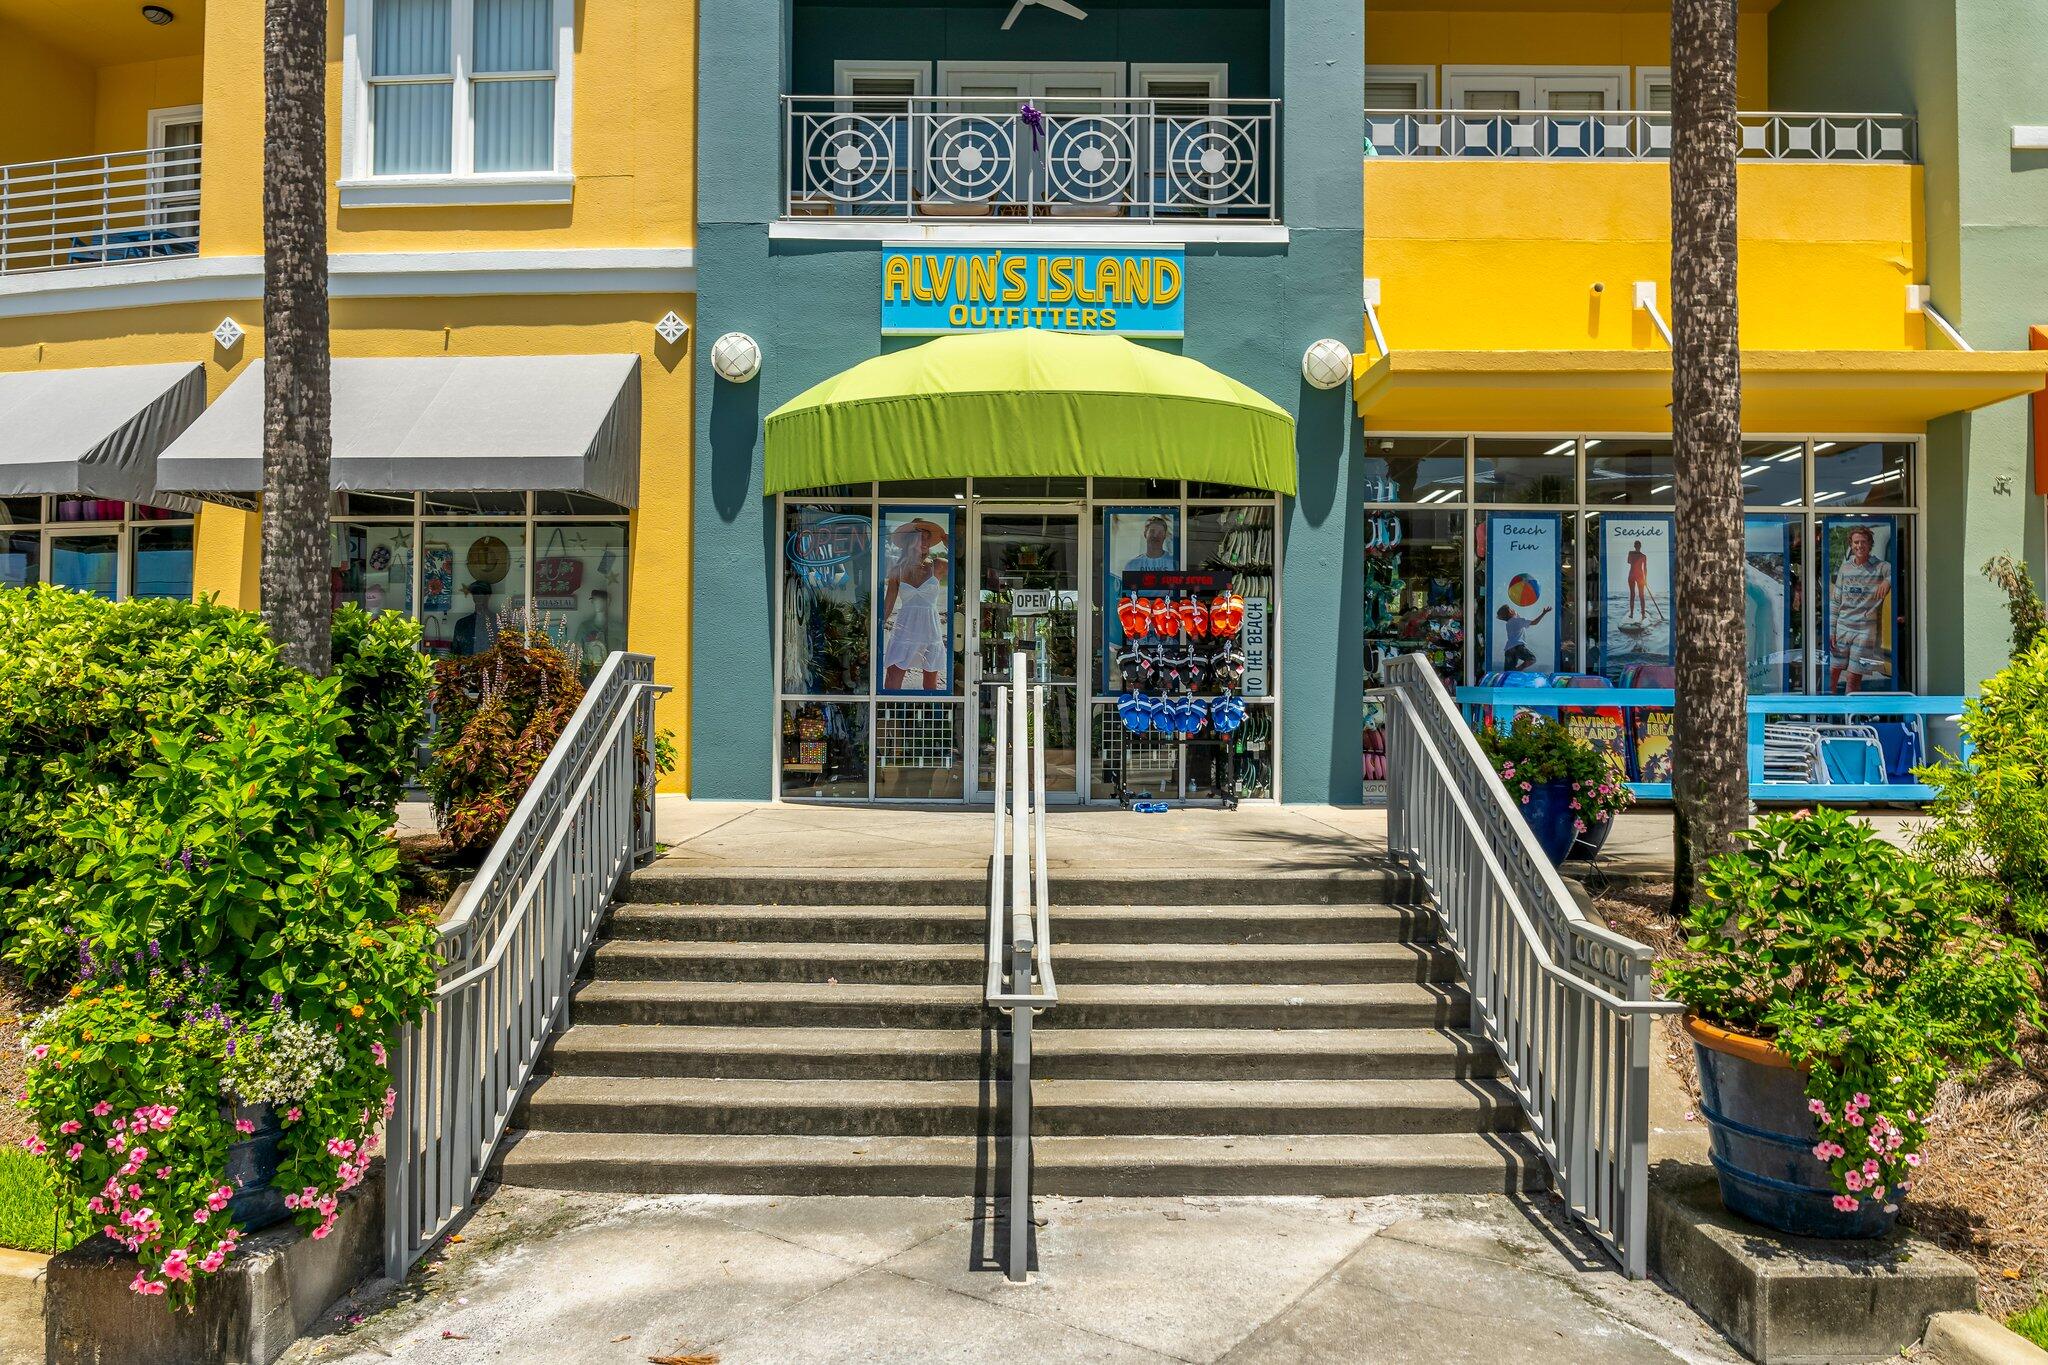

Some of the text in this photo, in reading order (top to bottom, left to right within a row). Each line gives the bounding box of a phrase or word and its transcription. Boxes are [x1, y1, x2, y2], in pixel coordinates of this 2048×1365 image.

[884, 250, 1181, 304] ALVIN'S ISLAND
[1503, 524, 1547, 535] Beach
[1614, 526, 1663, 537] Seaside
[796, 524, 868, 557] OPEN
[1510, 540, 1539, 551] Fun
[1017, 594, 1047, 607] OPEN
[1247, 602, 1263, 692] TO THE BEACH
[1568, 715, 1616, 728] ALVIN'S
[1647, 712, 1674, 725] ALVI
[1568, 727, 1617, 740] ISLAND
[1647, 723, 1674, 736] ISLA
